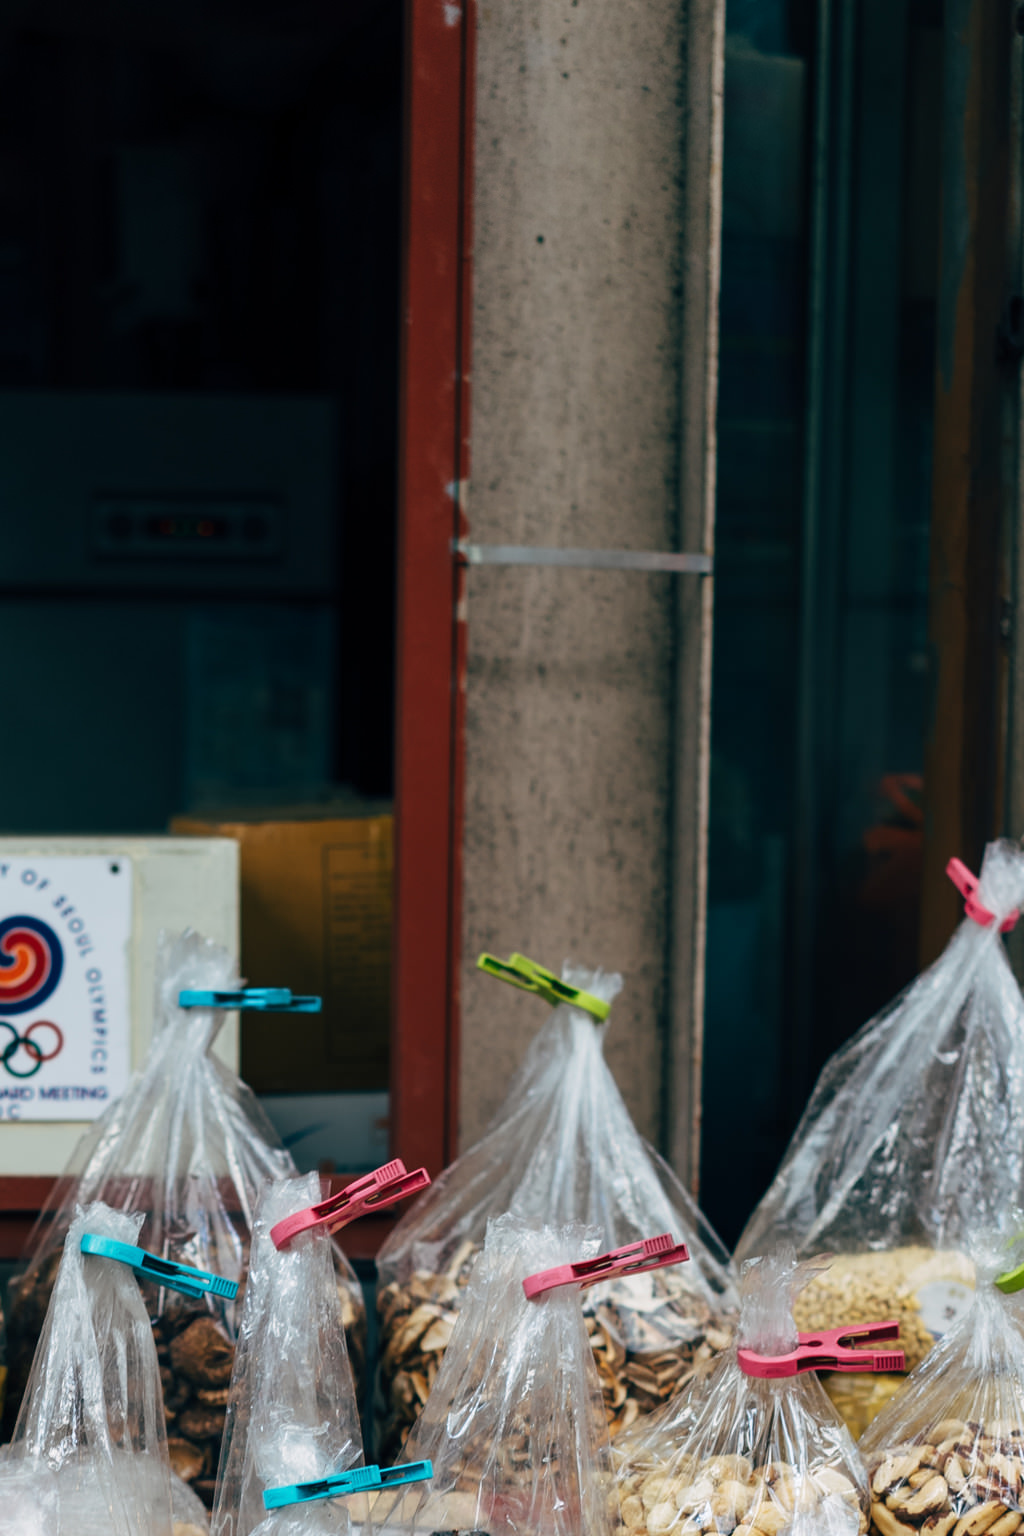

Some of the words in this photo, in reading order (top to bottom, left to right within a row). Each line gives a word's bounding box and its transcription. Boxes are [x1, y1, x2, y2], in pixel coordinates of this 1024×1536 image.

[20, 868, 50, 892] OF
[51, 894, 95, 959] SEOUL
[85, 967, 109, 1075] OLYMPICS
[40, 1086, 109, 1101] MEETING
